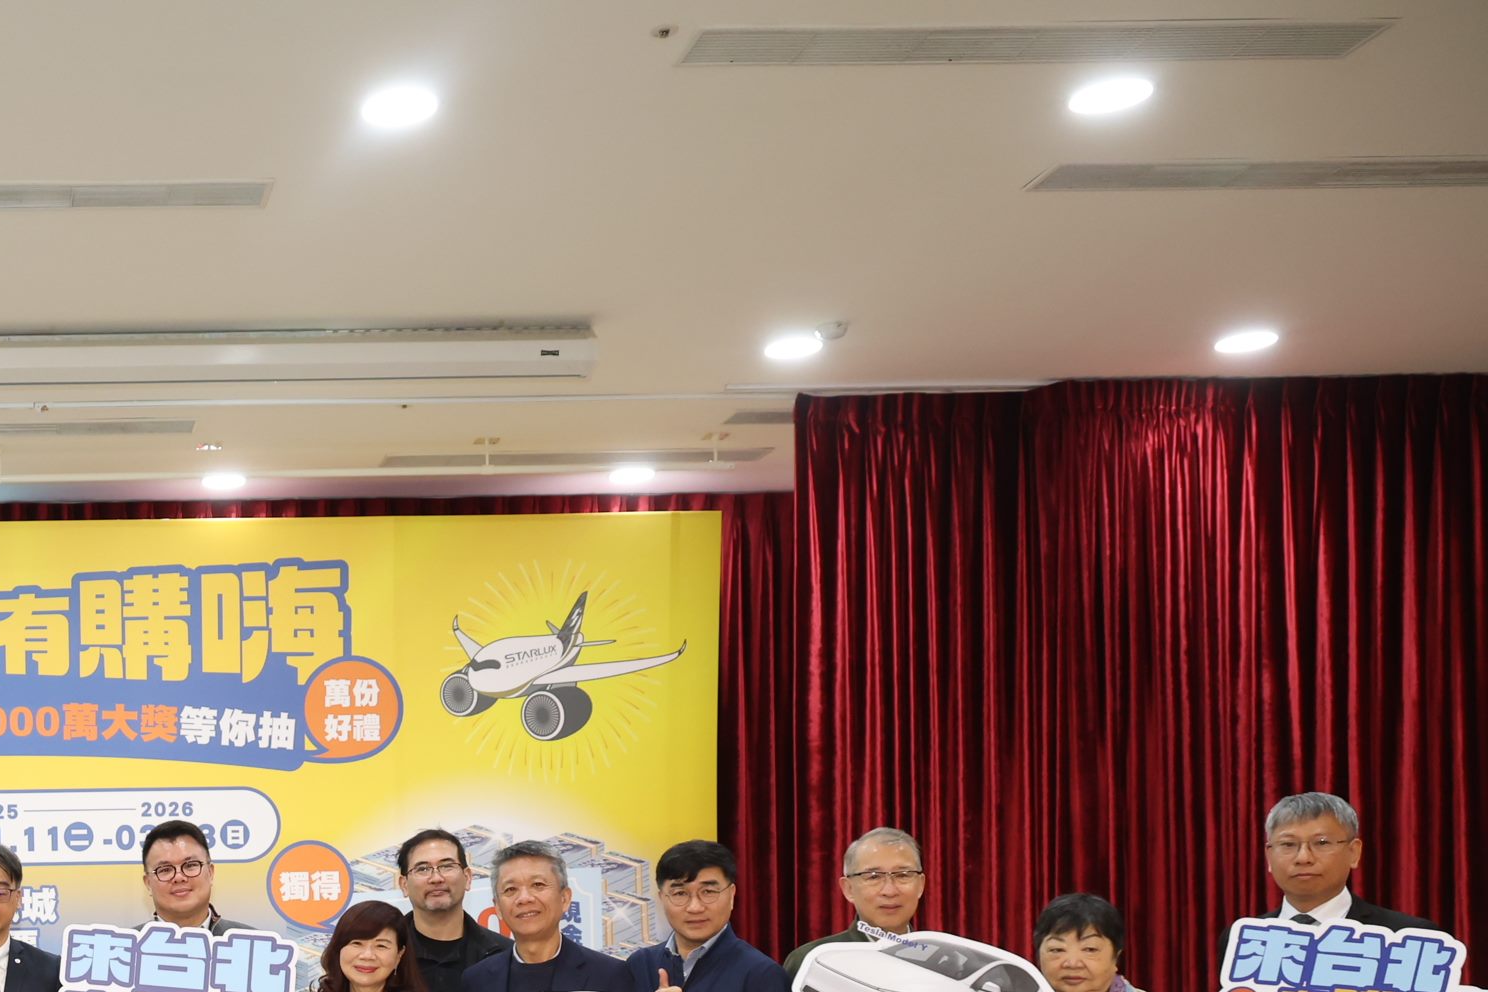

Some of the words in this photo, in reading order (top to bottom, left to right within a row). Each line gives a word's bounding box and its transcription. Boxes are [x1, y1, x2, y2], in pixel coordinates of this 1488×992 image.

[504, 644, 557, 664] STARLUX
[324, 679, 380, 708] 萬份
[324, 713, 381, 742] 好禮
[141, 802, 194, 817] 2026
[279, 870, 341, 902] 獨得
[858, 922, 886, 938] Tesla
[887, 932, 919, 949] Model
[919, 943, 928, 952] Y
[1233, 928, 1452, 992] 來台北
